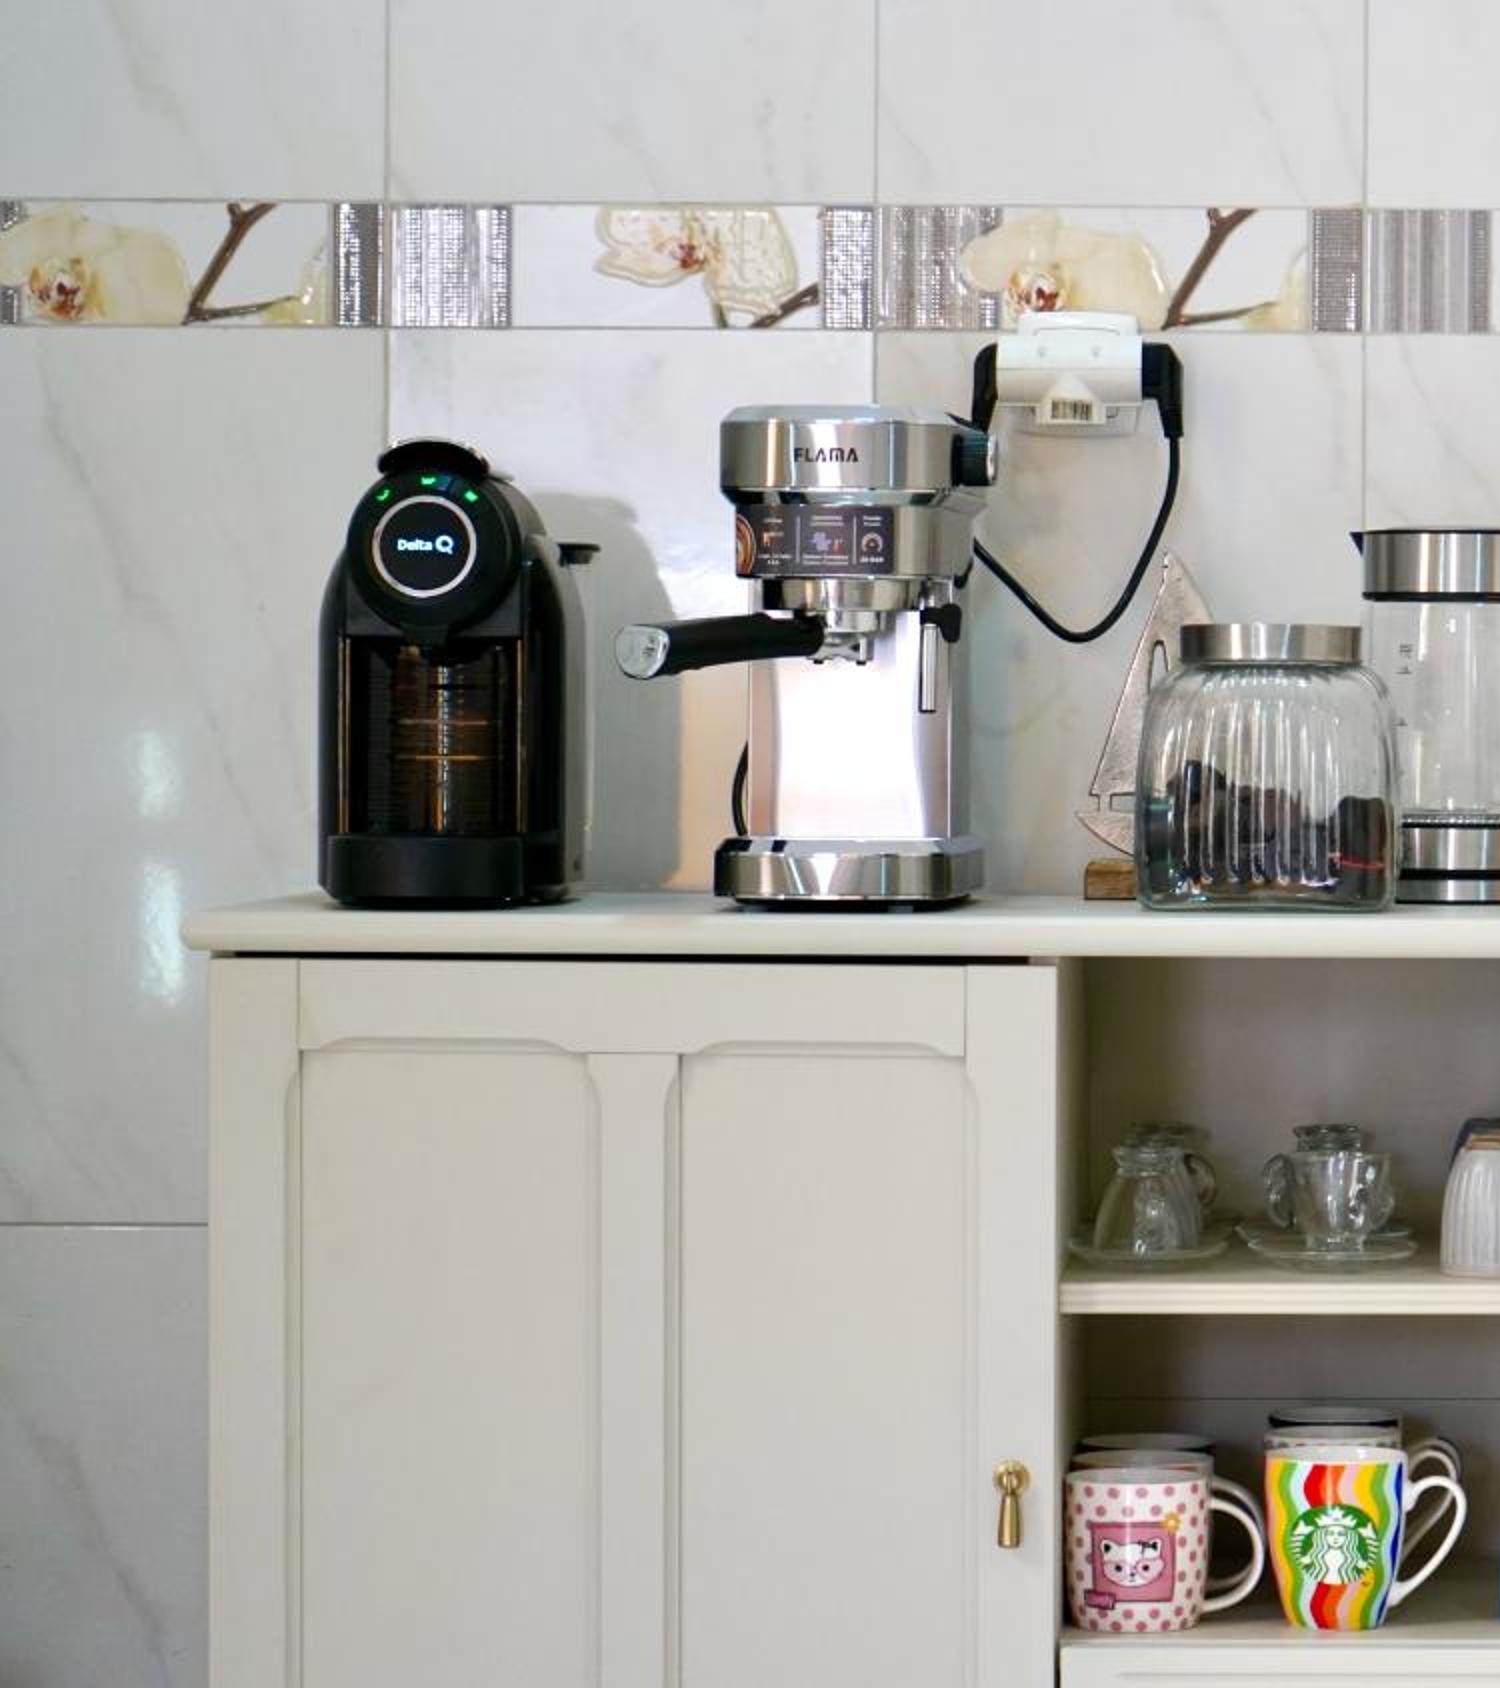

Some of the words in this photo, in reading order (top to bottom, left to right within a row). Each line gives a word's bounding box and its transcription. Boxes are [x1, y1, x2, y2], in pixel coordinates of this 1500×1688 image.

[794, 447, 858, 462] FLAMA
[398, 539, 432, 551] Delta
[435, 535, 454, 555] Q
